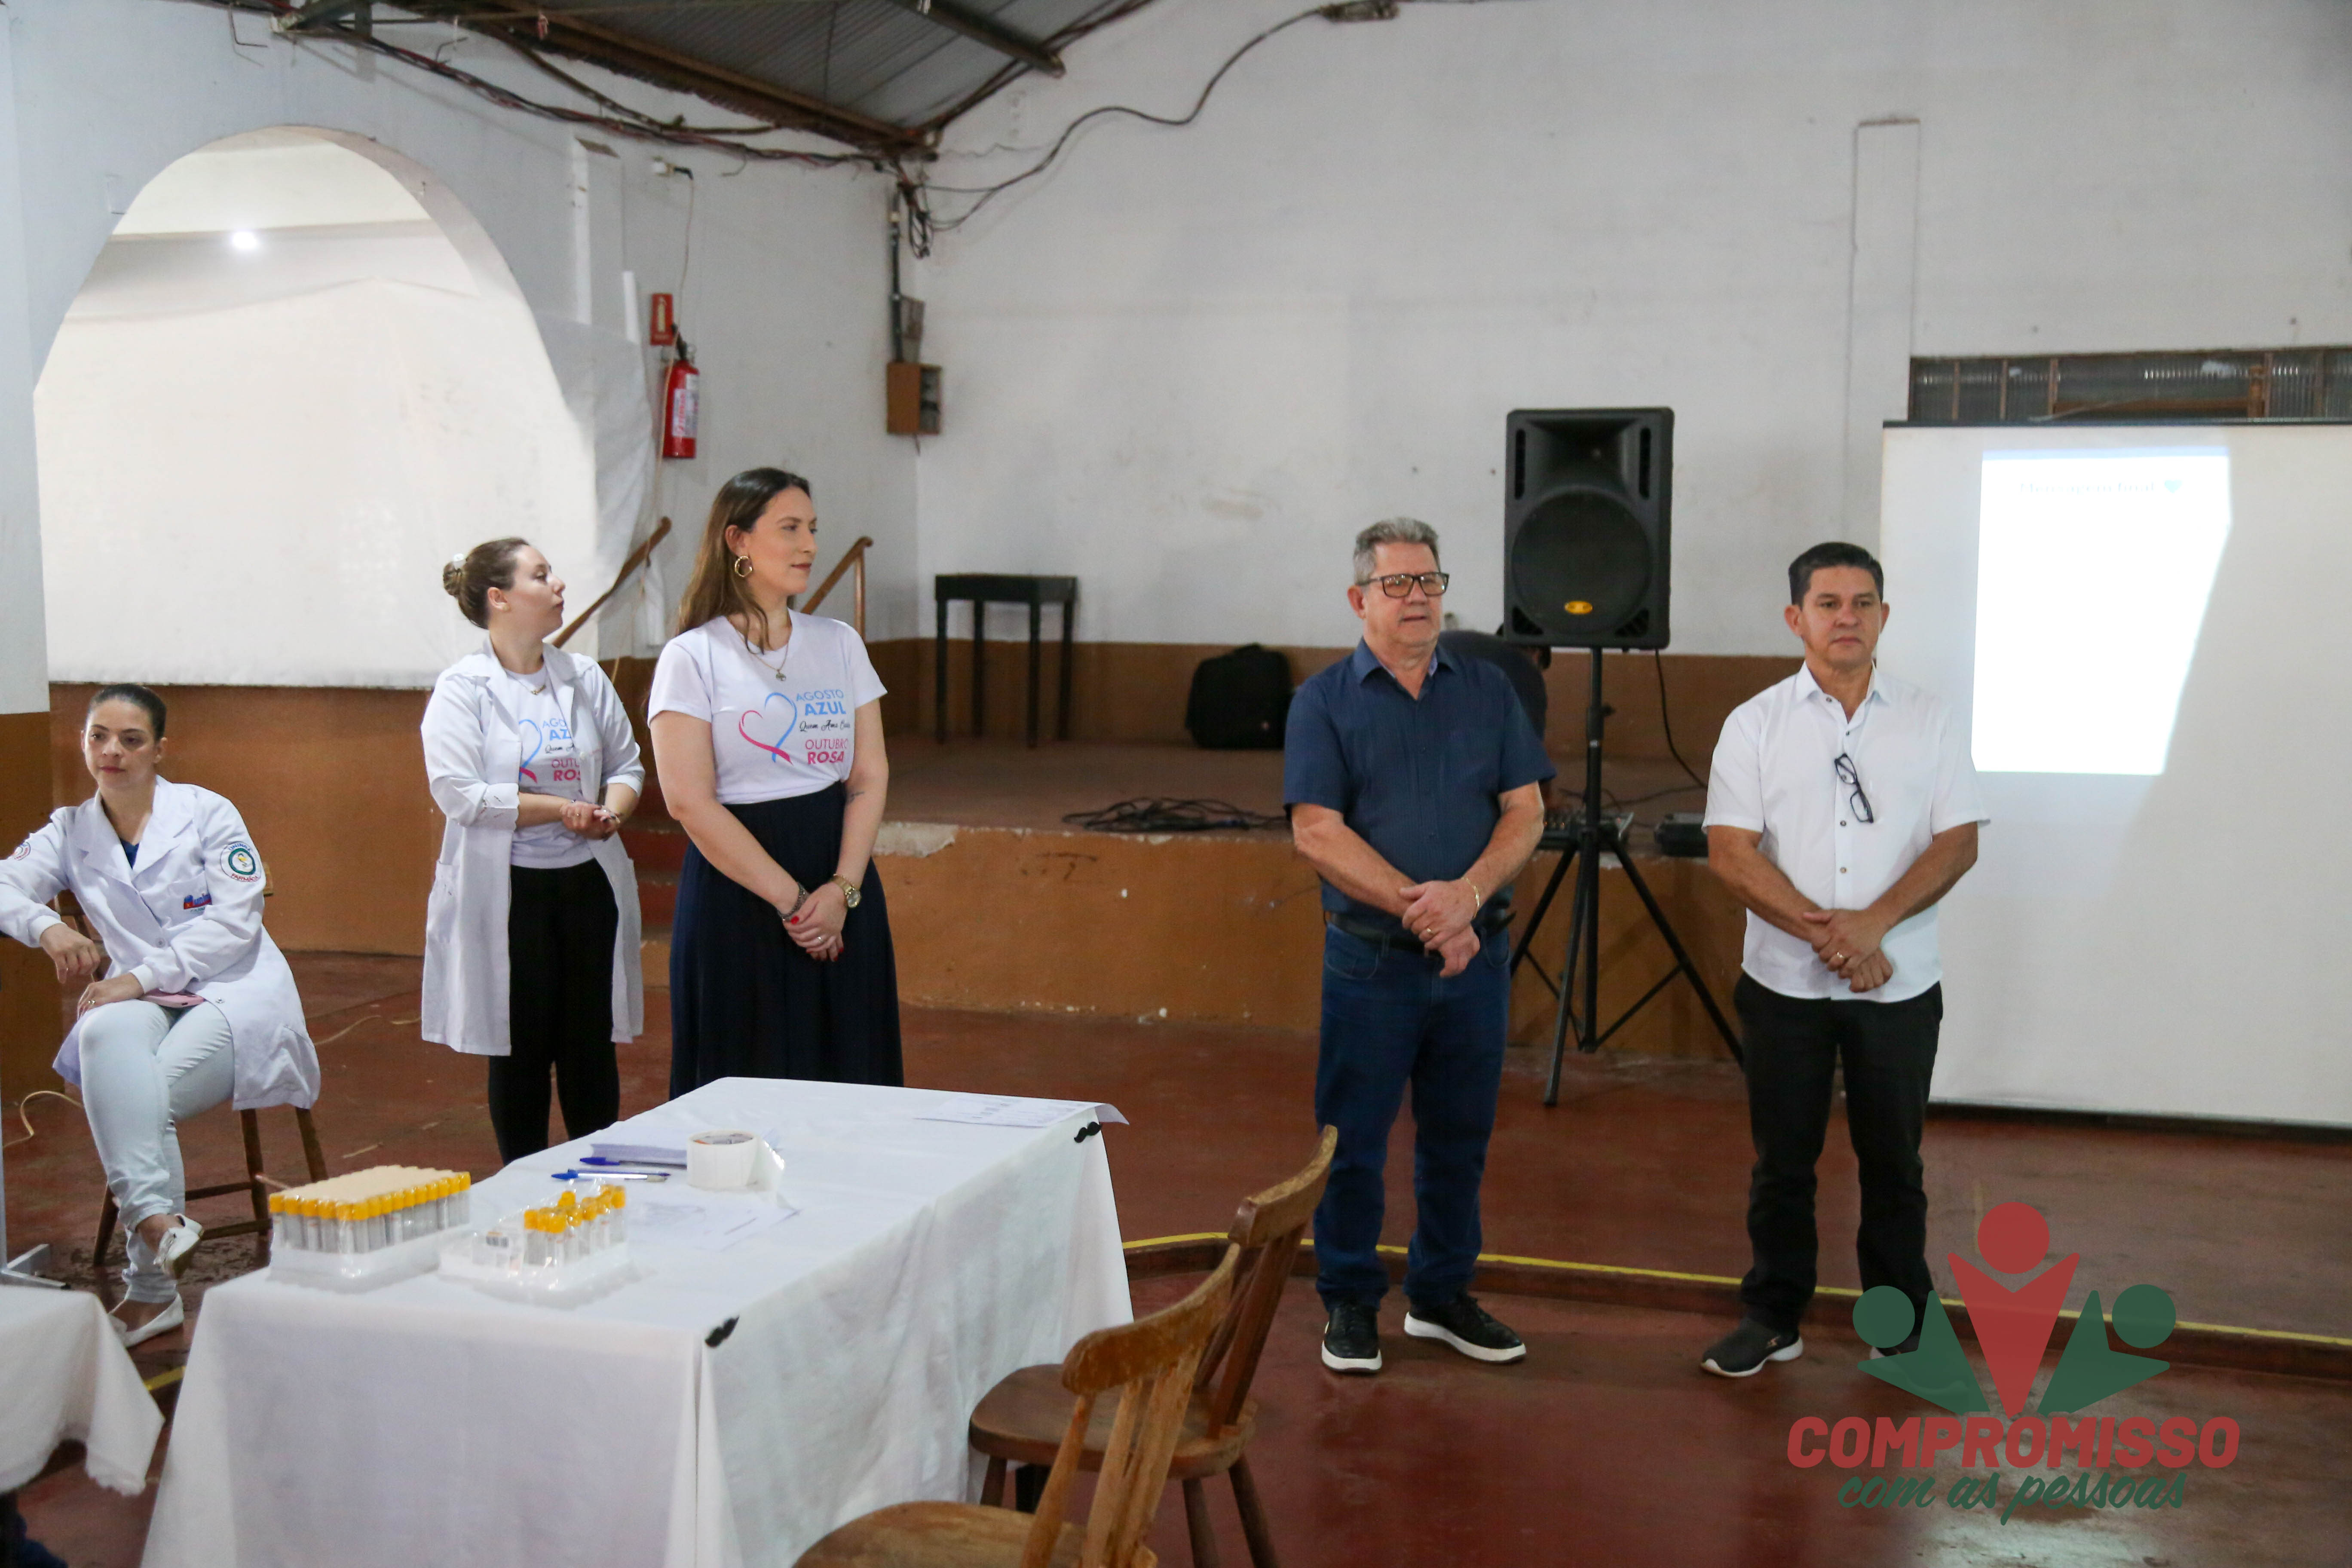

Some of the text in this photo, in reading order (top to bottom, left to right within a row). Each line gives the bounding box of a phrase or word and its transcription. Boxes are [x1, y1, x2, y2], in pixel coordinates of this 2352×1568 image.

[796, 689, 844, 701] AGOSTO
[805, 701, 846, 715] AZUL
[543, 718, 567, 728] AGO
[800, 720, 818, 732] Quem
[550, 729, 571, 741] AZ
[552, 758, 580, 768] OUTU
[808, 751, 844, 765] ROSA
